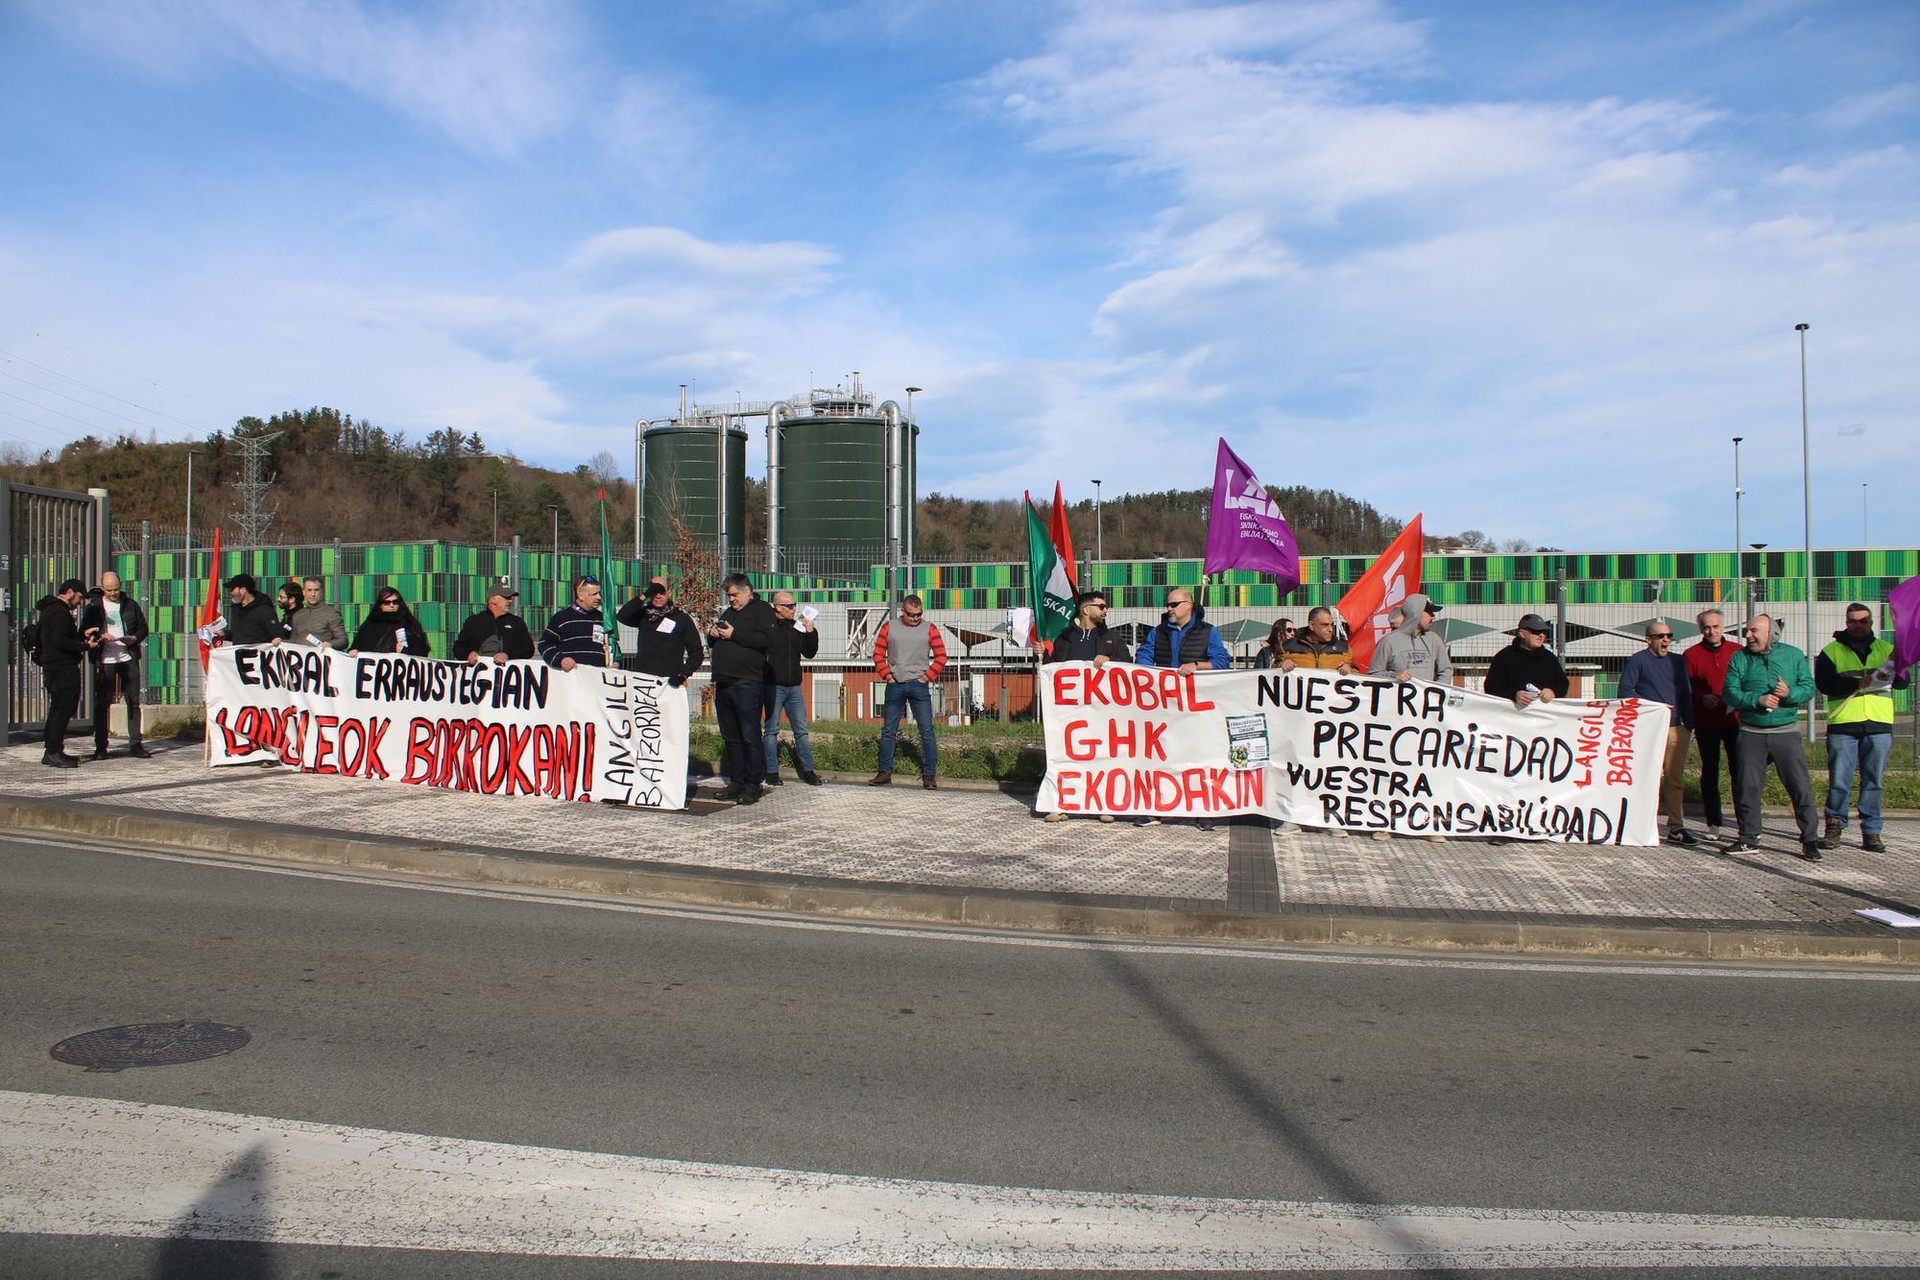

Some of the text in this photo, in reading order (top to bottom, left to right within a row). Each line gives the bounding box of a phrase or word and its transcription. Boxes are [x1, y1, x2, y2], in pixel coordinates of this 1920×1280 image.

[1043, 597, 1072, 621] SKAL
[234, 648, 340, 697] EKOBAL
[1053, 667, 1215, 712] EKOBAL
[1257, 675, 1446, 722] NUESTRA
[216, 704, 596, 803] LANGLEOK BORROKAN!
[600, 672, 635, 805] LANGILE
[633, 676, 665, 807] BATZORDEA!
[1064, 718, 1168, 762] GHK
[1057, 767, 1265, 812] EKONDAKIN
[1287, 761, 1433, 798] VUESTRA
